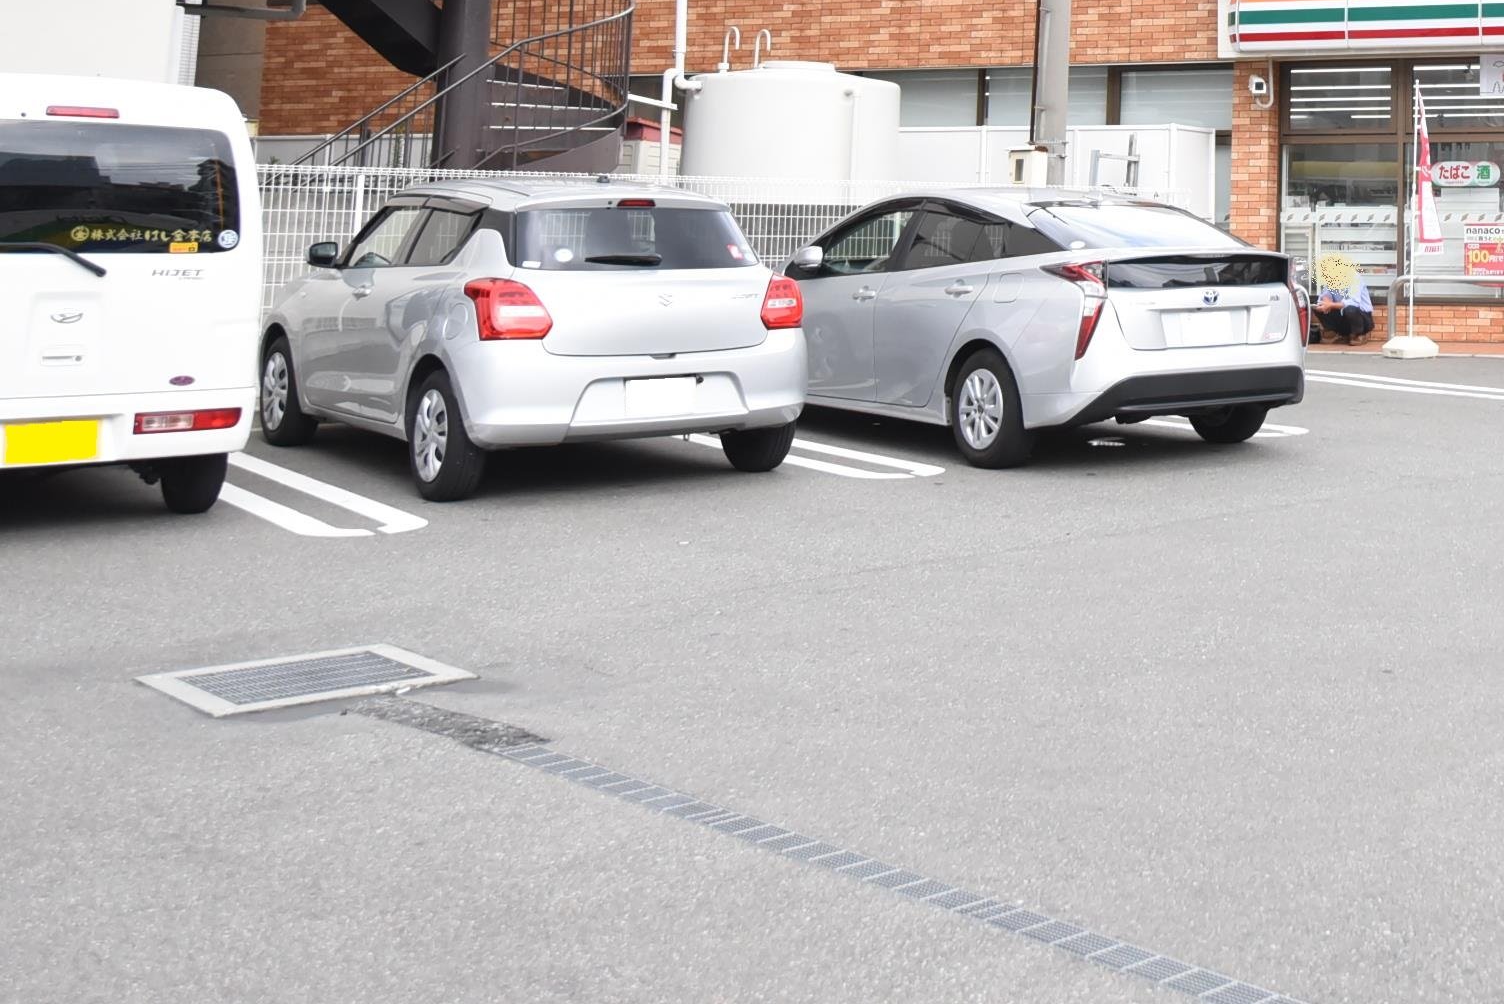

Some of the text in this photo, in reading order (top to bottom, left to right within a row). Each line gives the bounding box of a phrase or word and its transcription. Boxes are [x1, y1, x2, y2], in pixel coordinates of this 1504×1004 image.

[1439, 164, 1470, 179] たばこ
[1476, 164, 1491, 179] 酒
